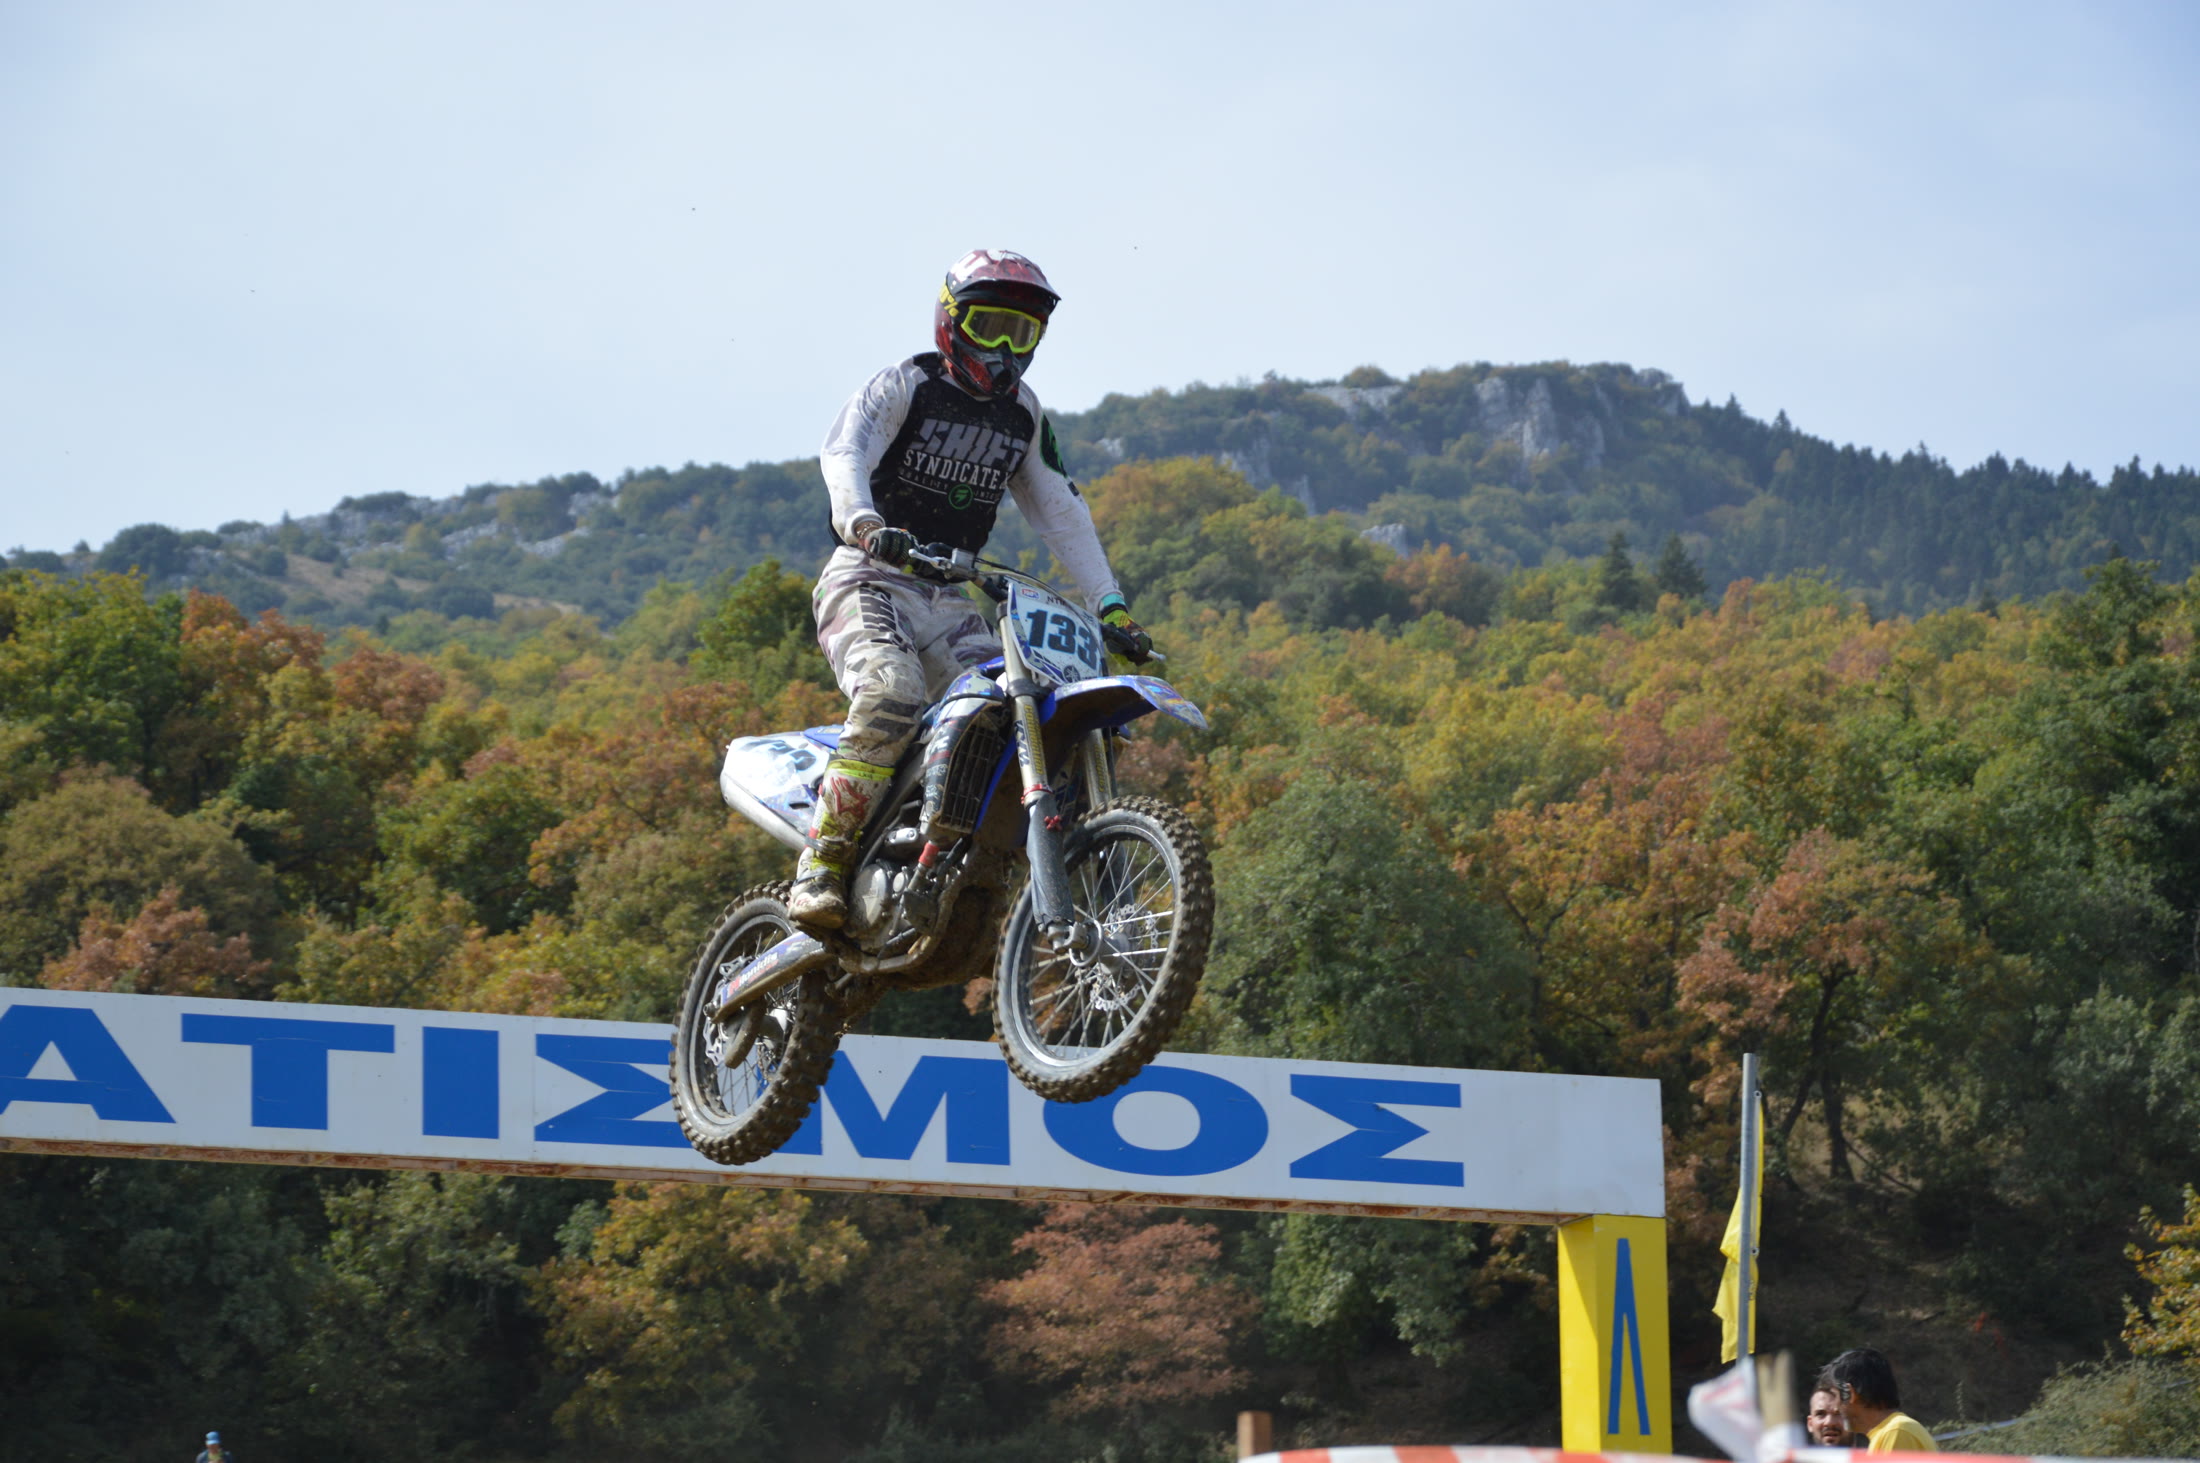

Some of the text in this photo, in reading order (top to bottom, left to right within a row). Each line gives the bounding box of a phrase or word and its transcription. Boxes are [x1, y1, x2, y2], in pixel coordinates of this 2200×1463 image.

[903, 449, 1002, 490] SYNDICATE
[910, 418, 1029, 473] SHIFT
[1027, 608, 1099, 671] 133
